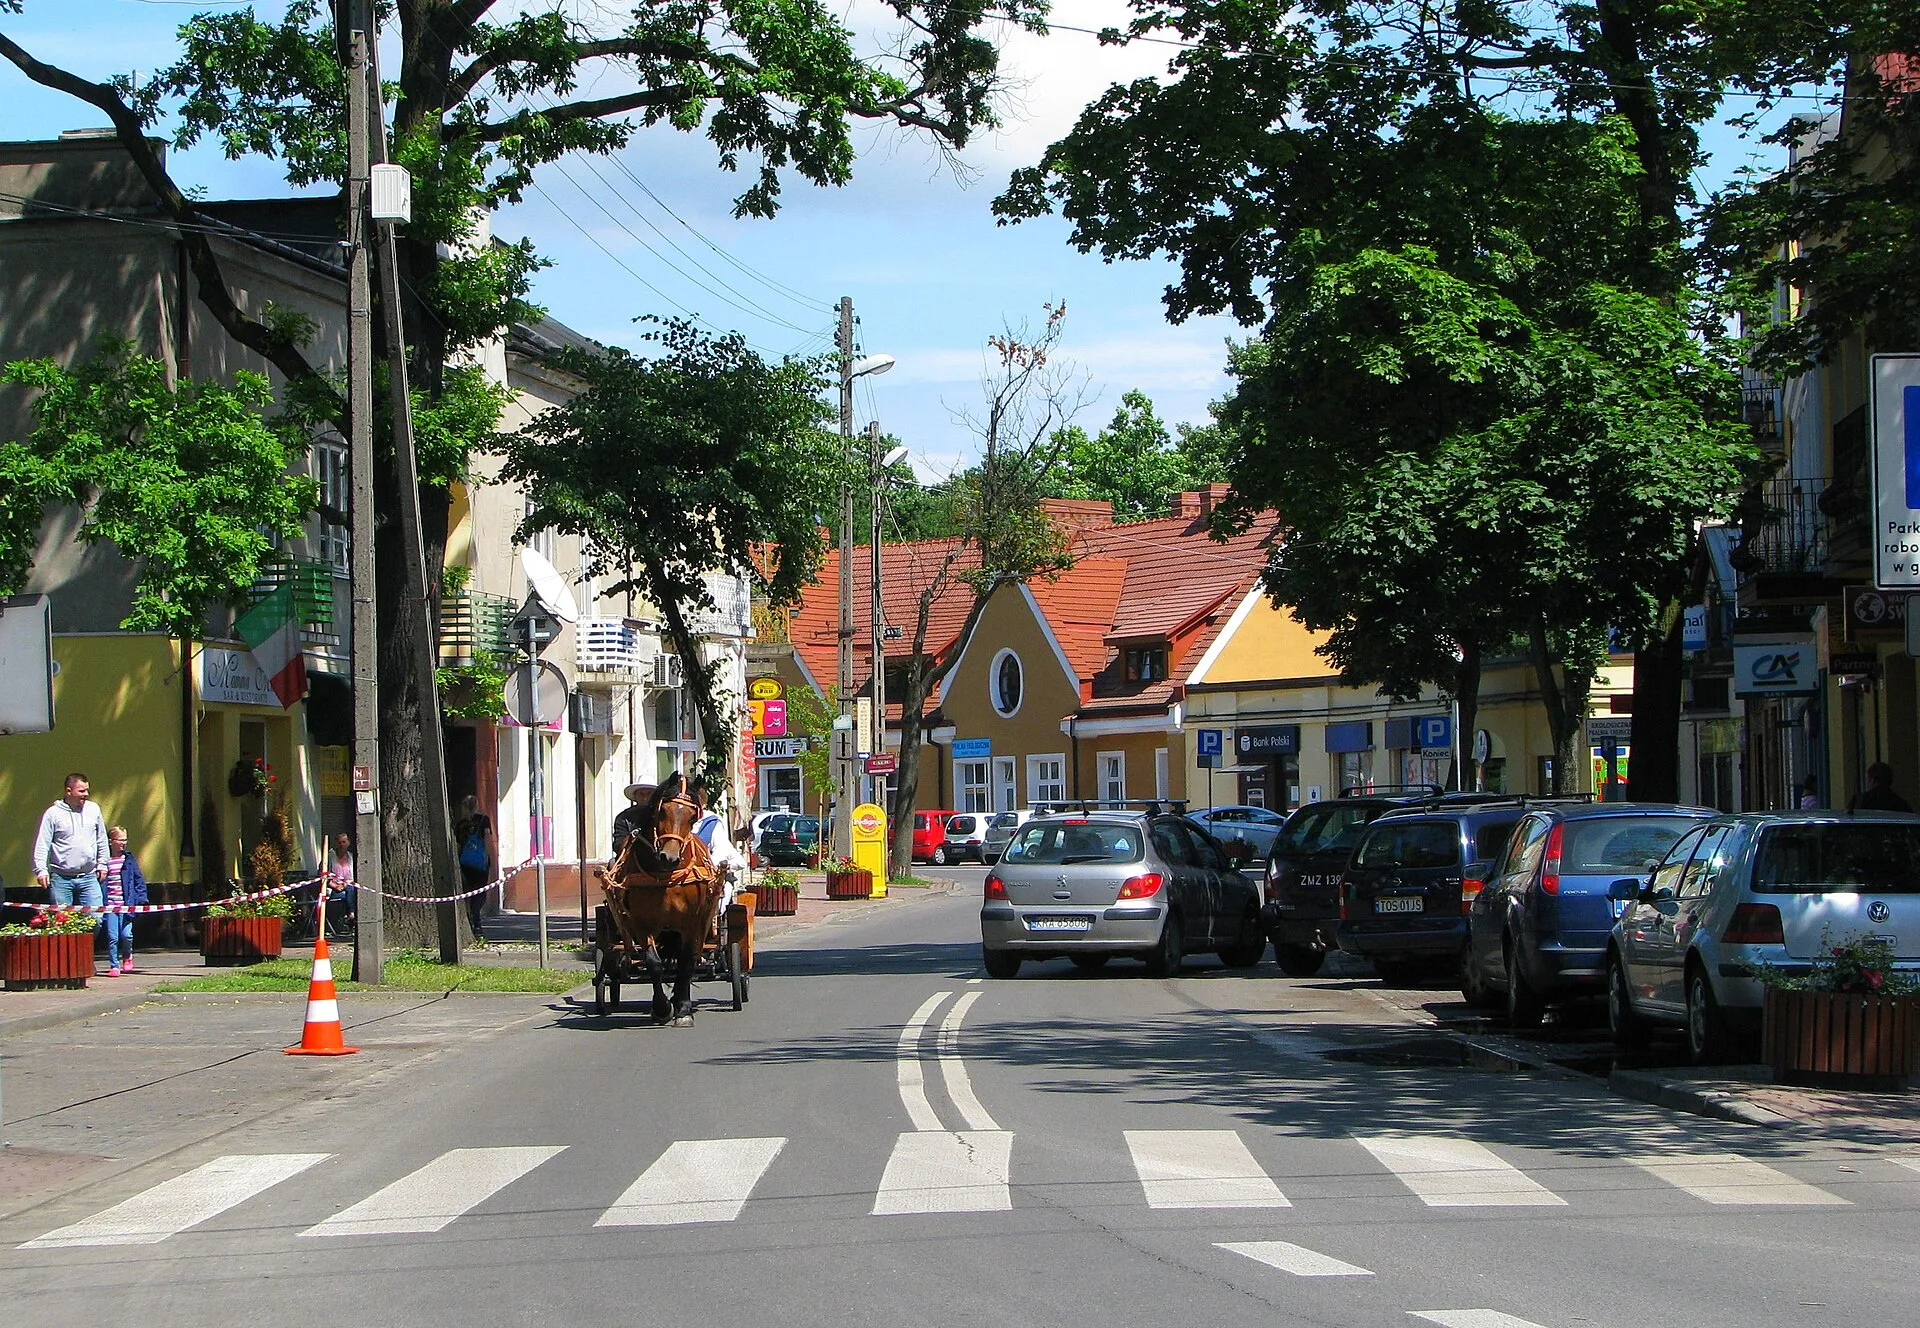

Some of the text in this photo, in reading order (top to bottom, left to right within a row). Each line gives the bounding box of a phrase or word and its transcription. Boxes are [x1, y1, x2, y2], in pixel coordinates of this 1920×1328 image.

[1893, 563, 1904, 572] w
[1253, 735, 1290, 747] Bank Polski
[1422, 749, 1449, 758] Koniec
[1300, 875, 1322, 886] ZMZ
[1380, 898, 1422, 912] TOS 01JS
[1037, 916, 1055, 928] KRA
